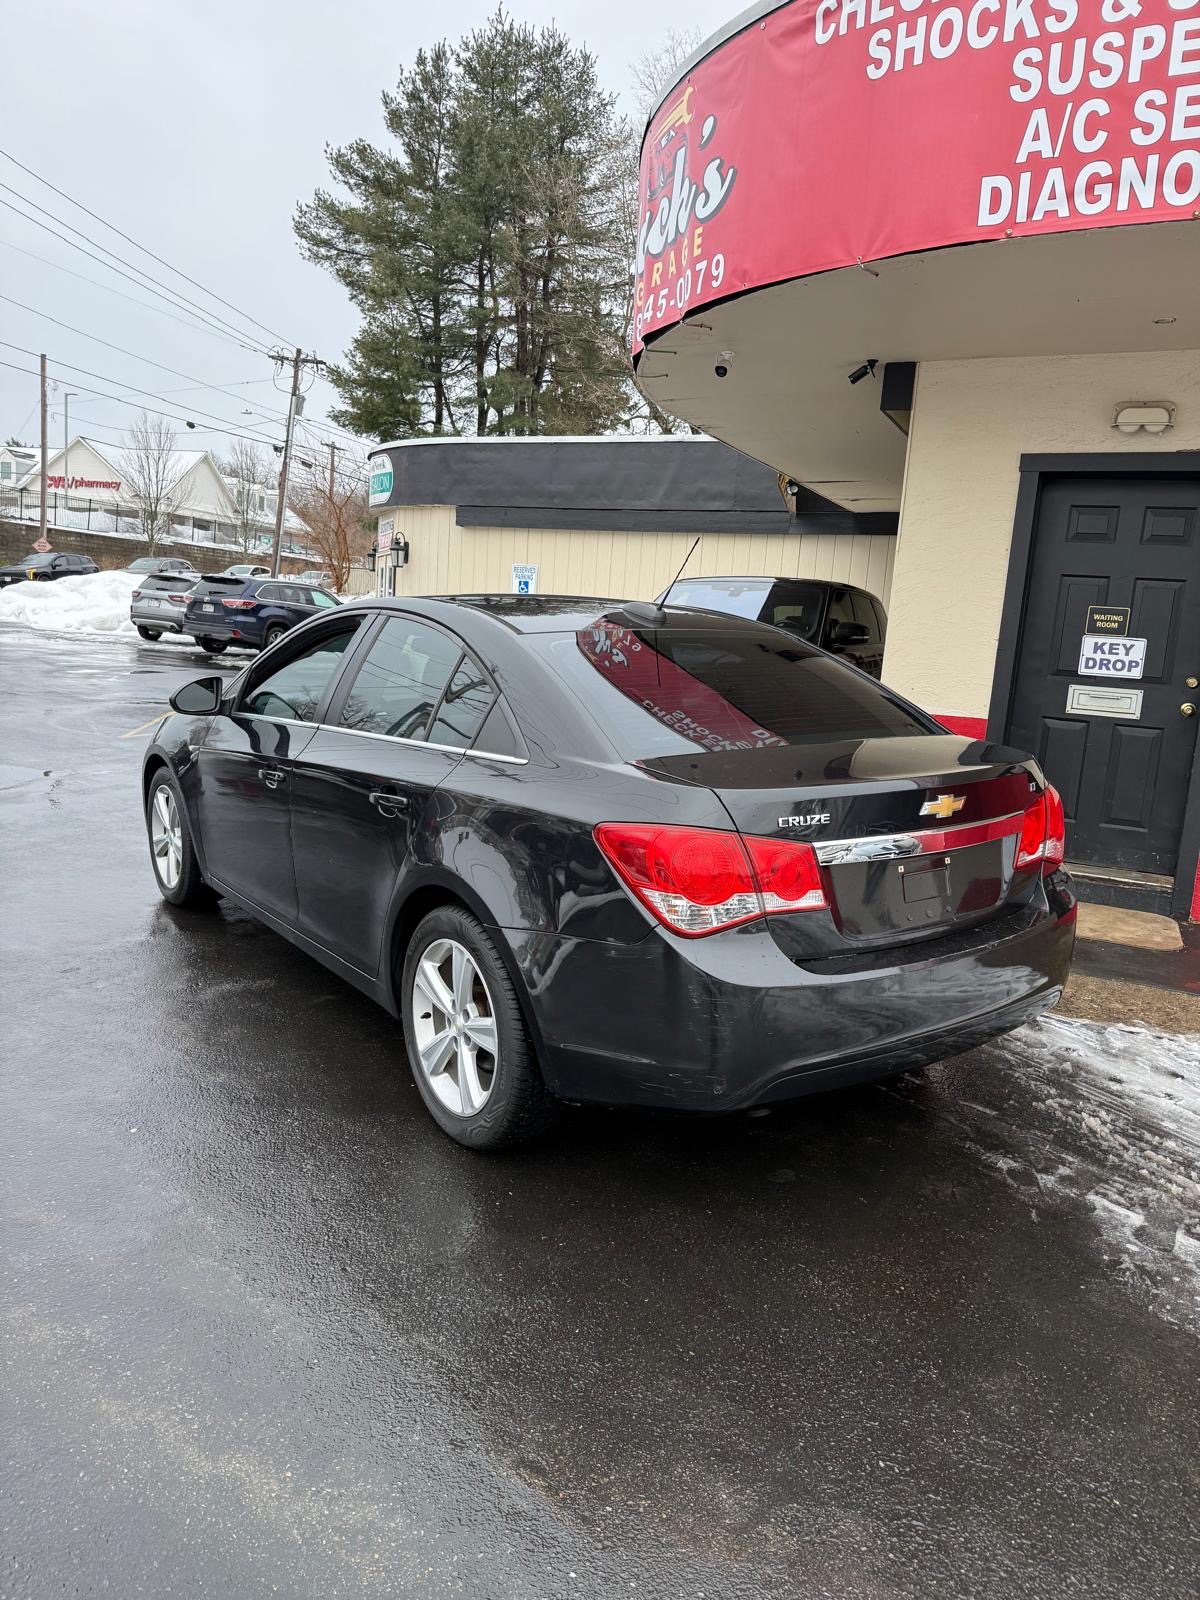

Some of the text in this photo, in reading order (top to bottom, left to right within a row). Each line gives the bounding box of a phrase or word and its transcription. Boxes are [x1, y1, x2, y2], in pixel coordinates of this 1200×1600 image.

[866, 0, 1079, 81] SHOCKS
[1015, 98, 1111, 164] A/C
[515, 573, 534, 581] PARKING
[1093, 613, 1124, 622] WAITING
[1096, 621, 1119, 629] ROOM
[1092, 641, 1136, 657] KEY
[1084, 657, 1140, 673] DROP
[778, 813, 831, 828] CRUZE
